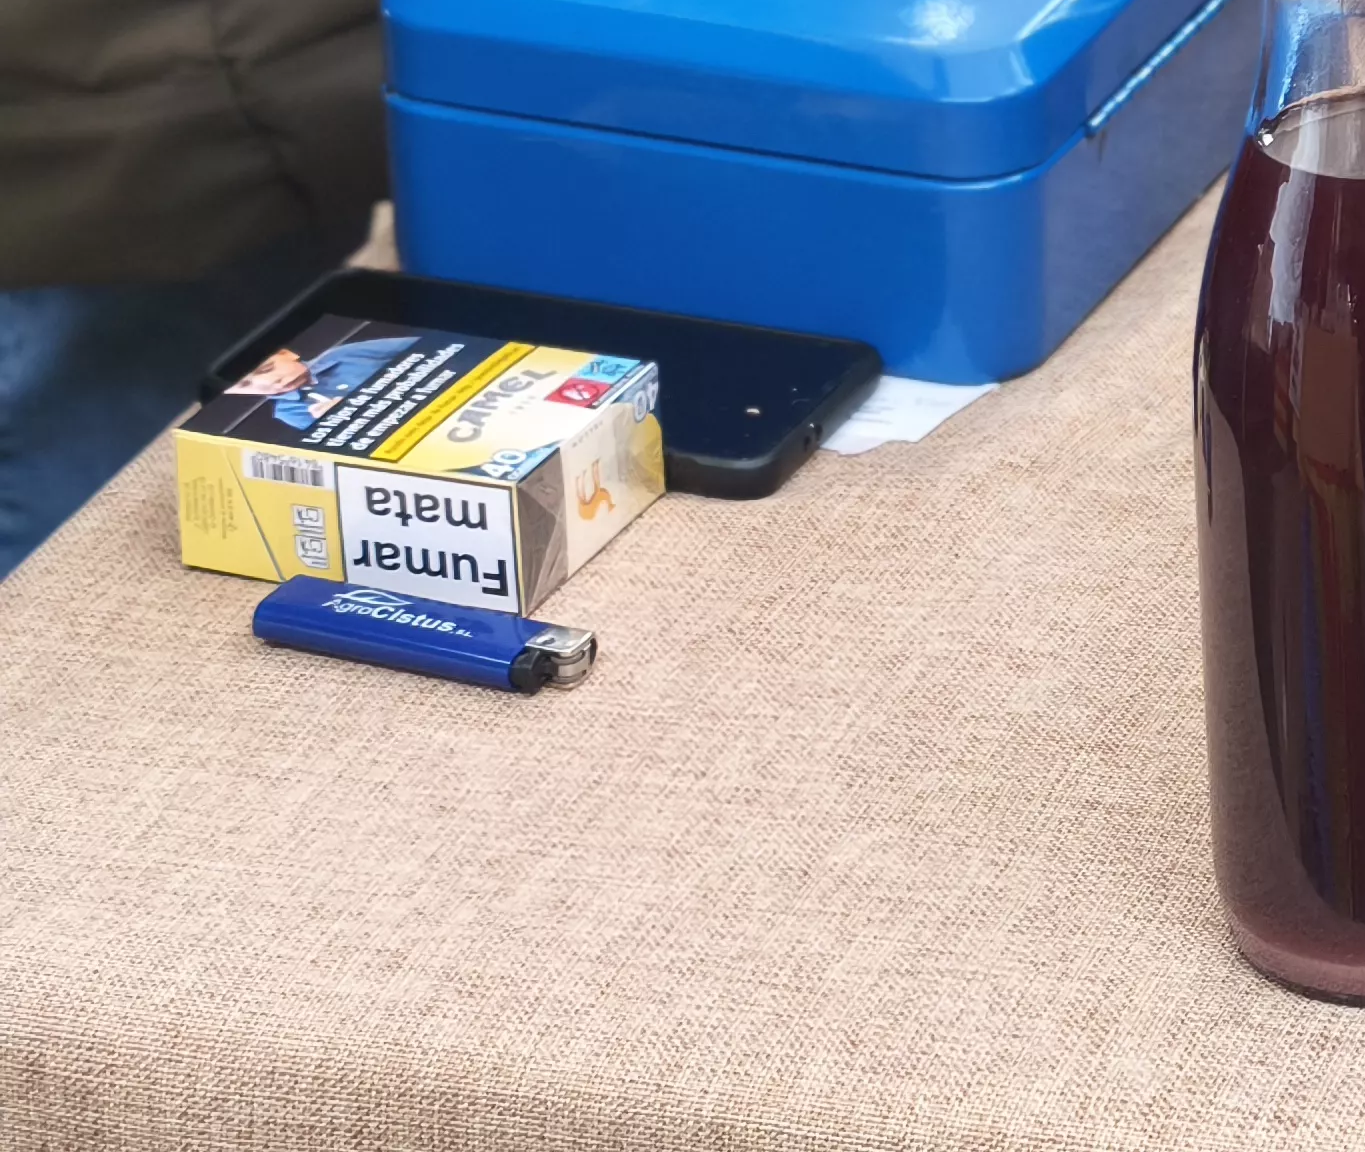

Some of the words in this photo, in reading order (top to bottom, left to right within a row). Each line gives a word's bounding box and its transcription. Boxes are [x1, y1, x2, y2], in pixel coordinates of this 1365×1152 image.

[446, 368, 558, 443] CAMEL
[481, 448, 527, 478] 40
[364, 485, 488, 531] mata
[353, 539, 509, 597] Fumar
